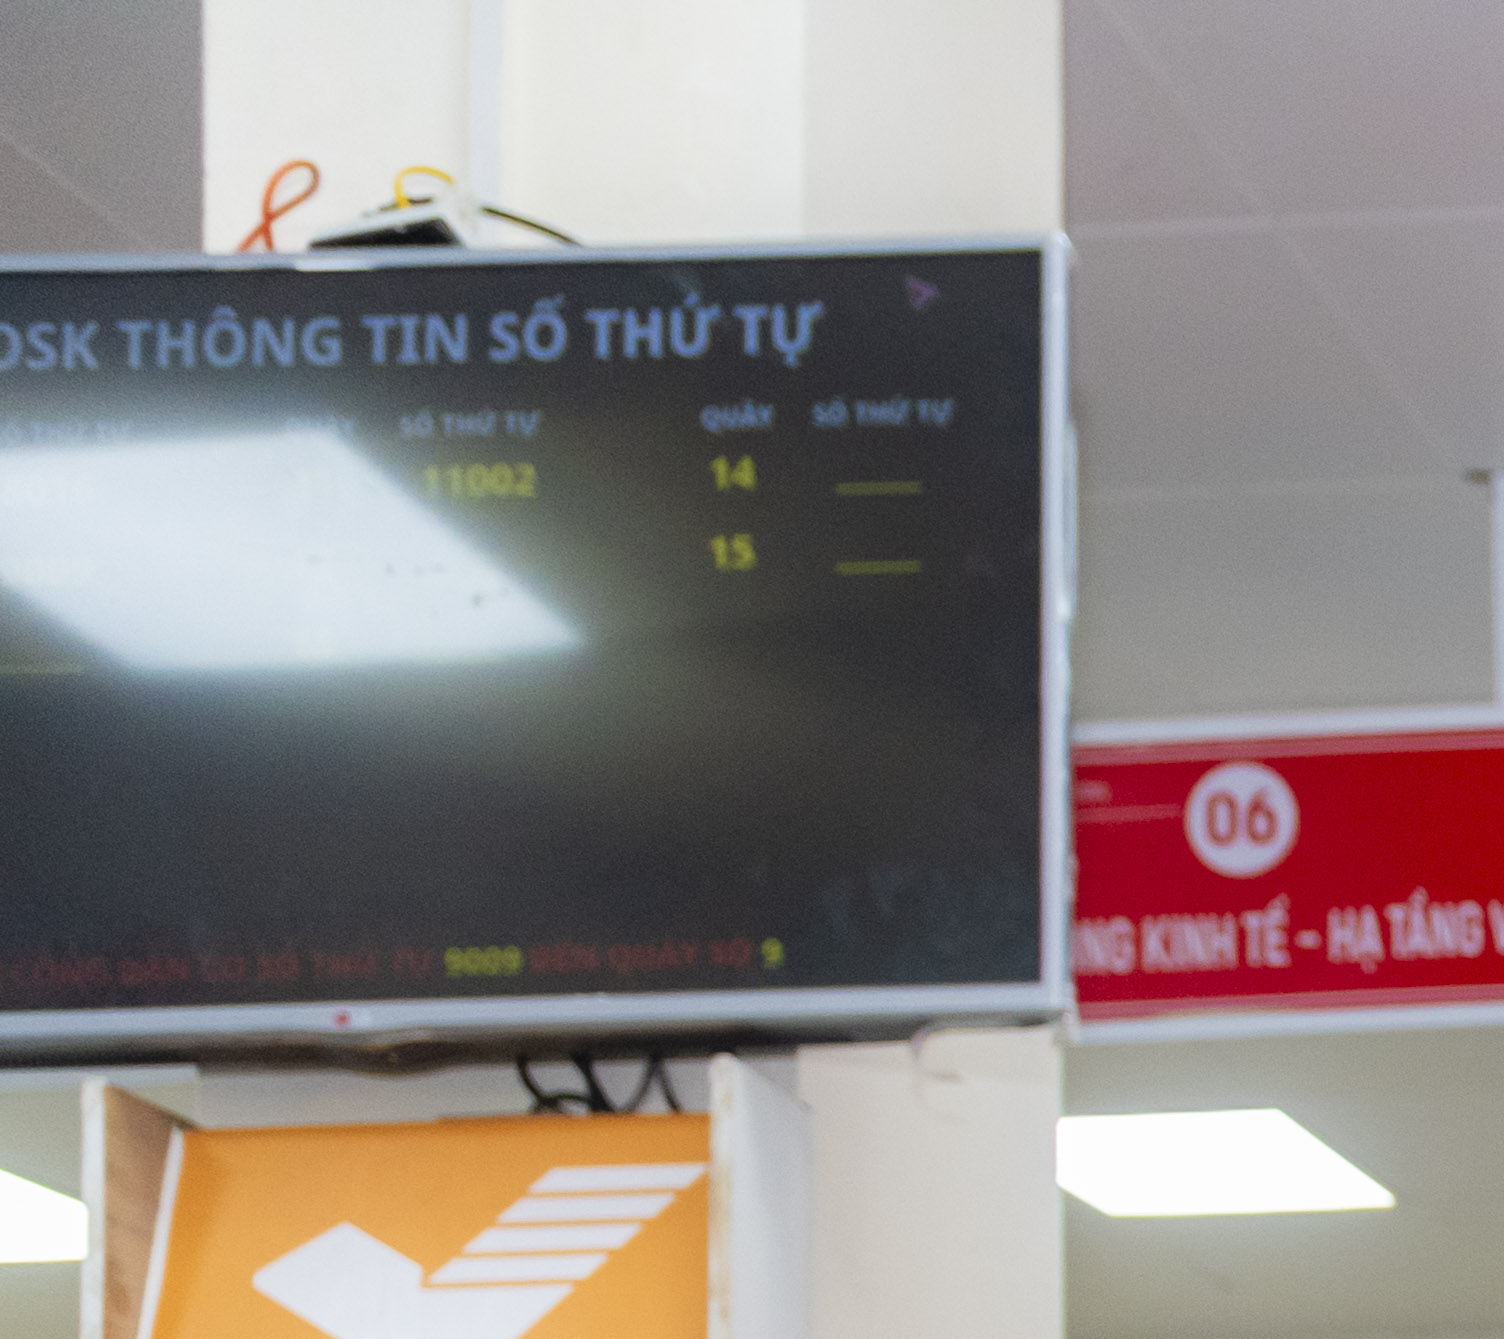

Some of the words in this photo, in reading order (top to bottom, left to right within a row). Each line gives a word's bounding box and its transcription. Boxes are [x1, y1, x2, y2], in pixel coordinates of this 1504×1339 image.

[116, 304, 343, 369] THÔNG
[361, 312, 469, 364] TIN
[488, 294, 568, 362] SỐ
[586, 293, 721, 361] THỨ
[733, 299, 824, 367] TỰ
[711, 455, 757, 491] 14
[710, 532, 757, 571] 15
[1207, 792, 1276, 847] 06
[760, 936, 784, 967] 9
[1140, 911, 1240, 975] KINH
[1326, 904, 1386, 974] HẠ
